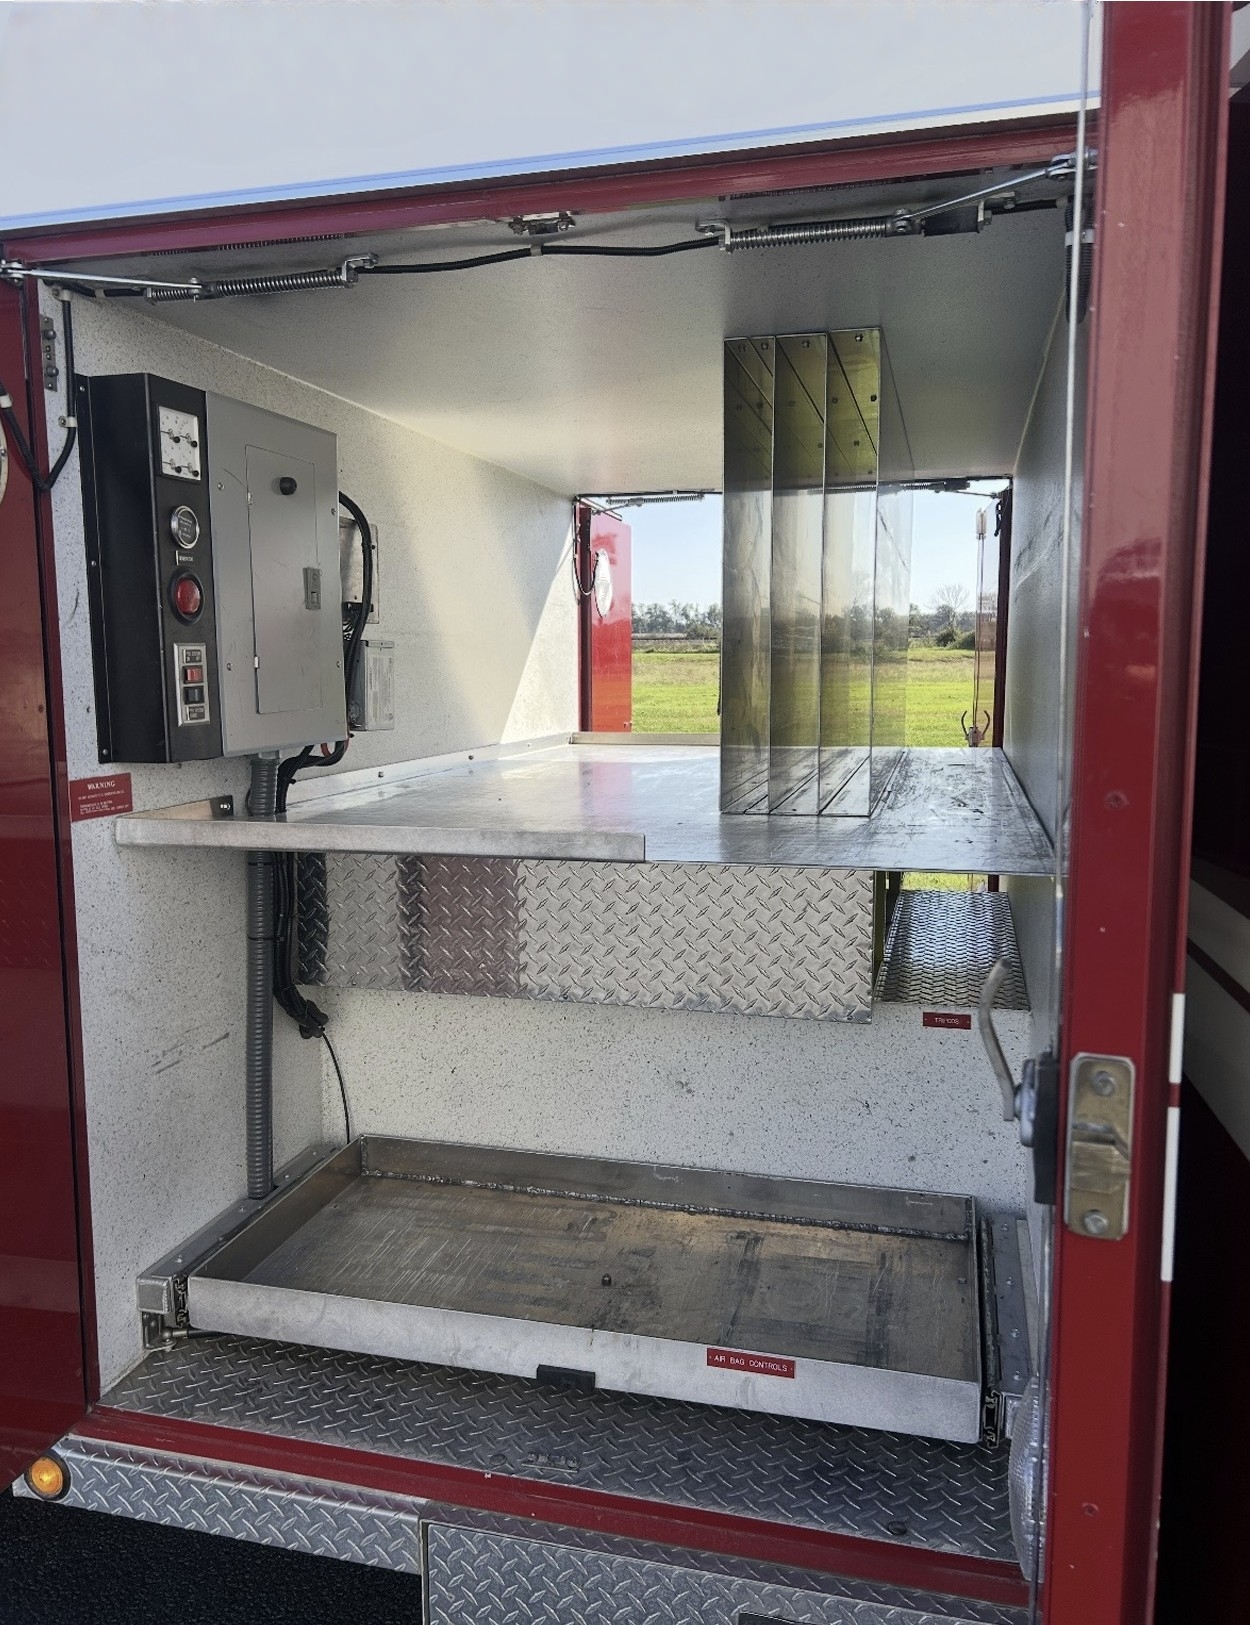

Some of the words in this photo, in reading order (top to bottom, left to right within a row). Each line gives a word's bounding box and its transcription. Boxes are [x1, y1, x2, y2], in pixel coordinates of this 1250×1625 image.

[87, 780, 116, 790] WARNING
[713, 1355, 726, 1363] AIR
[729, 1356, 745, 1366] BAG
[748, 1359, 788, 1372] CONTROLS
